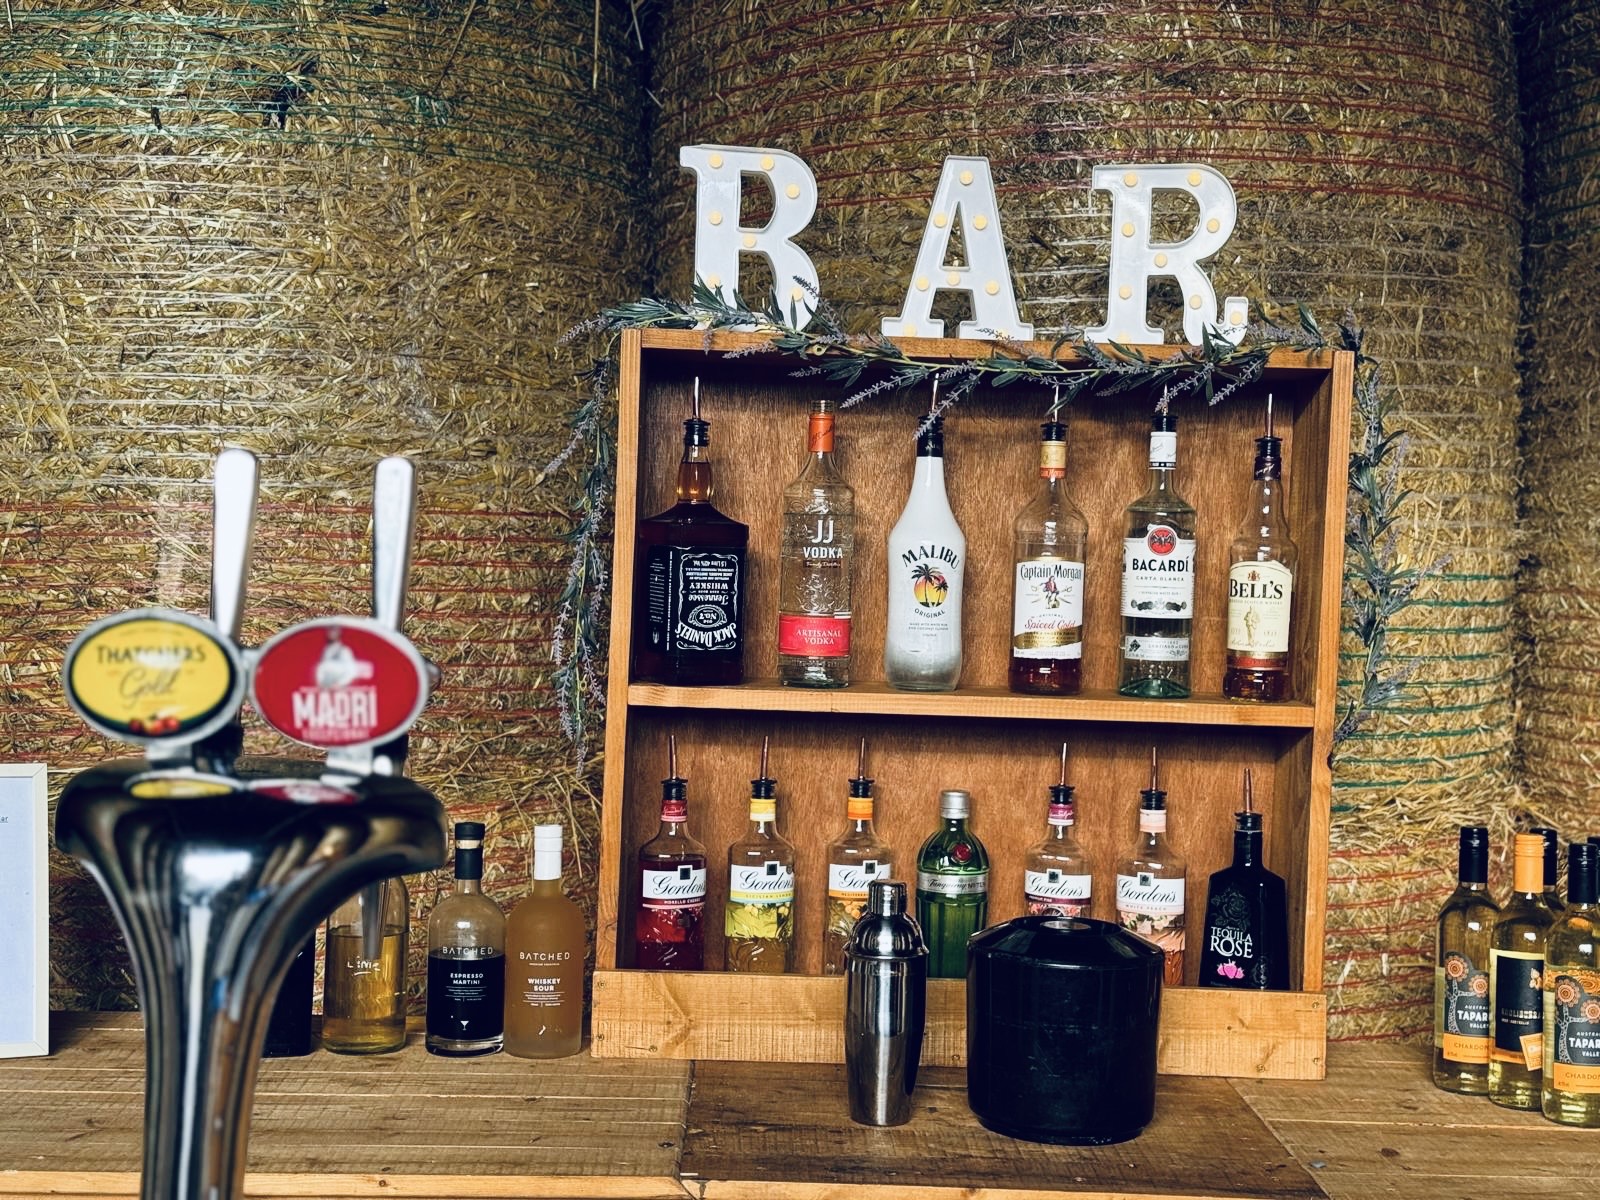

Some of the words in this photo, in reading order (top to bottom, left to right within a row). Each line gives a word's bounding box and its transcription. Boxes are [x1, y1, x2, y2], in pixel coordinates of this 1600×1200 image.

[679, 145, 1249, 346] BAR
[811, 519, 835, 544] JJ
[803, 546, 844, 559] VODKA
[902, 545, 960, 569] MALIBU
[1020, 564, 1052, 581] Captain
[1053, 564, 1082, 581] Morgan
[689, 582, 729, 590] WHISKEY
[1229, 579, 1283, 599] BELL'S
[688, 594, 729, 605] Tennessee
[914, 608, 946, 619] ORIGINAL
[1024, 619, 1055, 630] Spiced
[713, 622, 737, 643] JACK
[796, 629, 842, 638] ARTISANAL
[804, 637, 835, 645] VODKA
[1118, 879, 1177, 903] Gordon's
[1211, 926, 1252, 942] TEQUILA
[442, 946, 493, 955] BATCHED
[1210, 935, 1253, 958] ROSE
[519, 951, 570, 960] BATCHED
[1457, 1009, 1489, 1022] TAPAR
